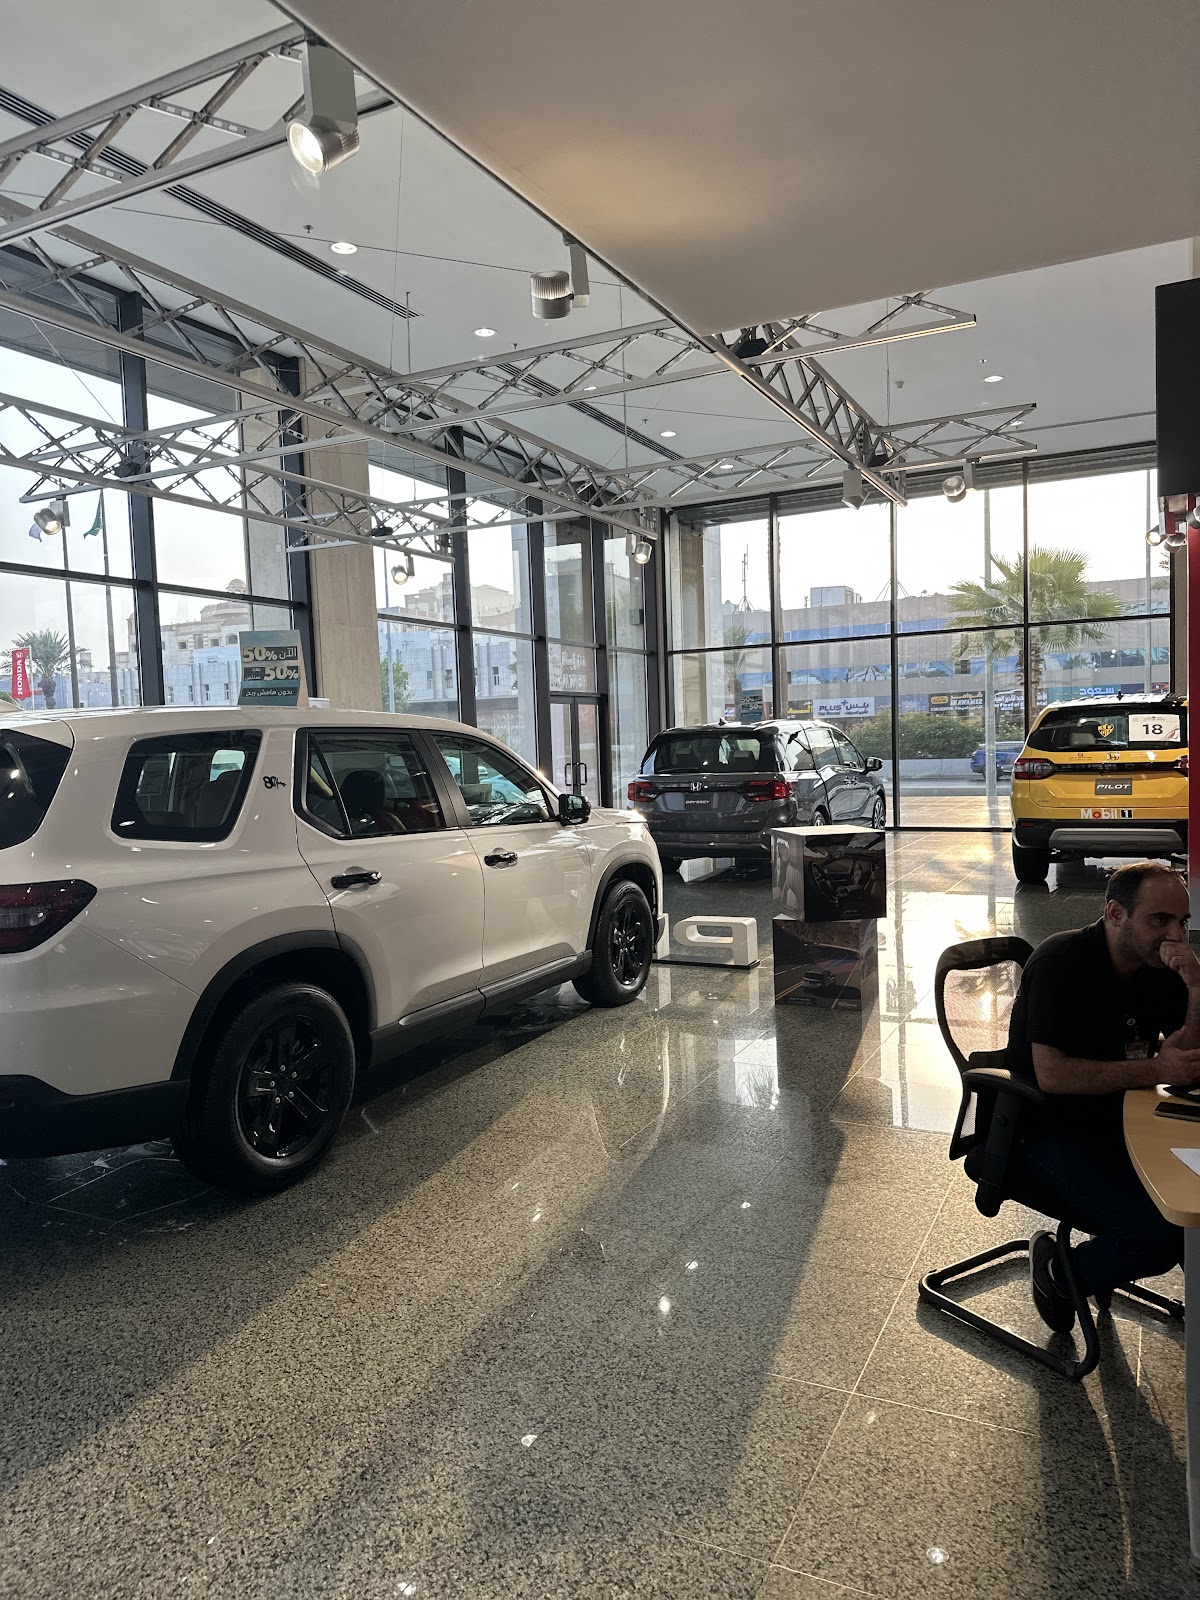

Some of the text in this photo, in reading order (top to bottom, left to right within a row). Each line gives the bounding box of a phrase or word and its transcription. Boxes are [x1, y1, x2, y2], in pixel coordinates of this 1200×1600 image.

[242, 646, 297, 663] الآن 50%
[264, 666, 299, 681] 50%
[1142, 723, 1164, 735] 18
[1080, 808, 1118, 819] Mobil
